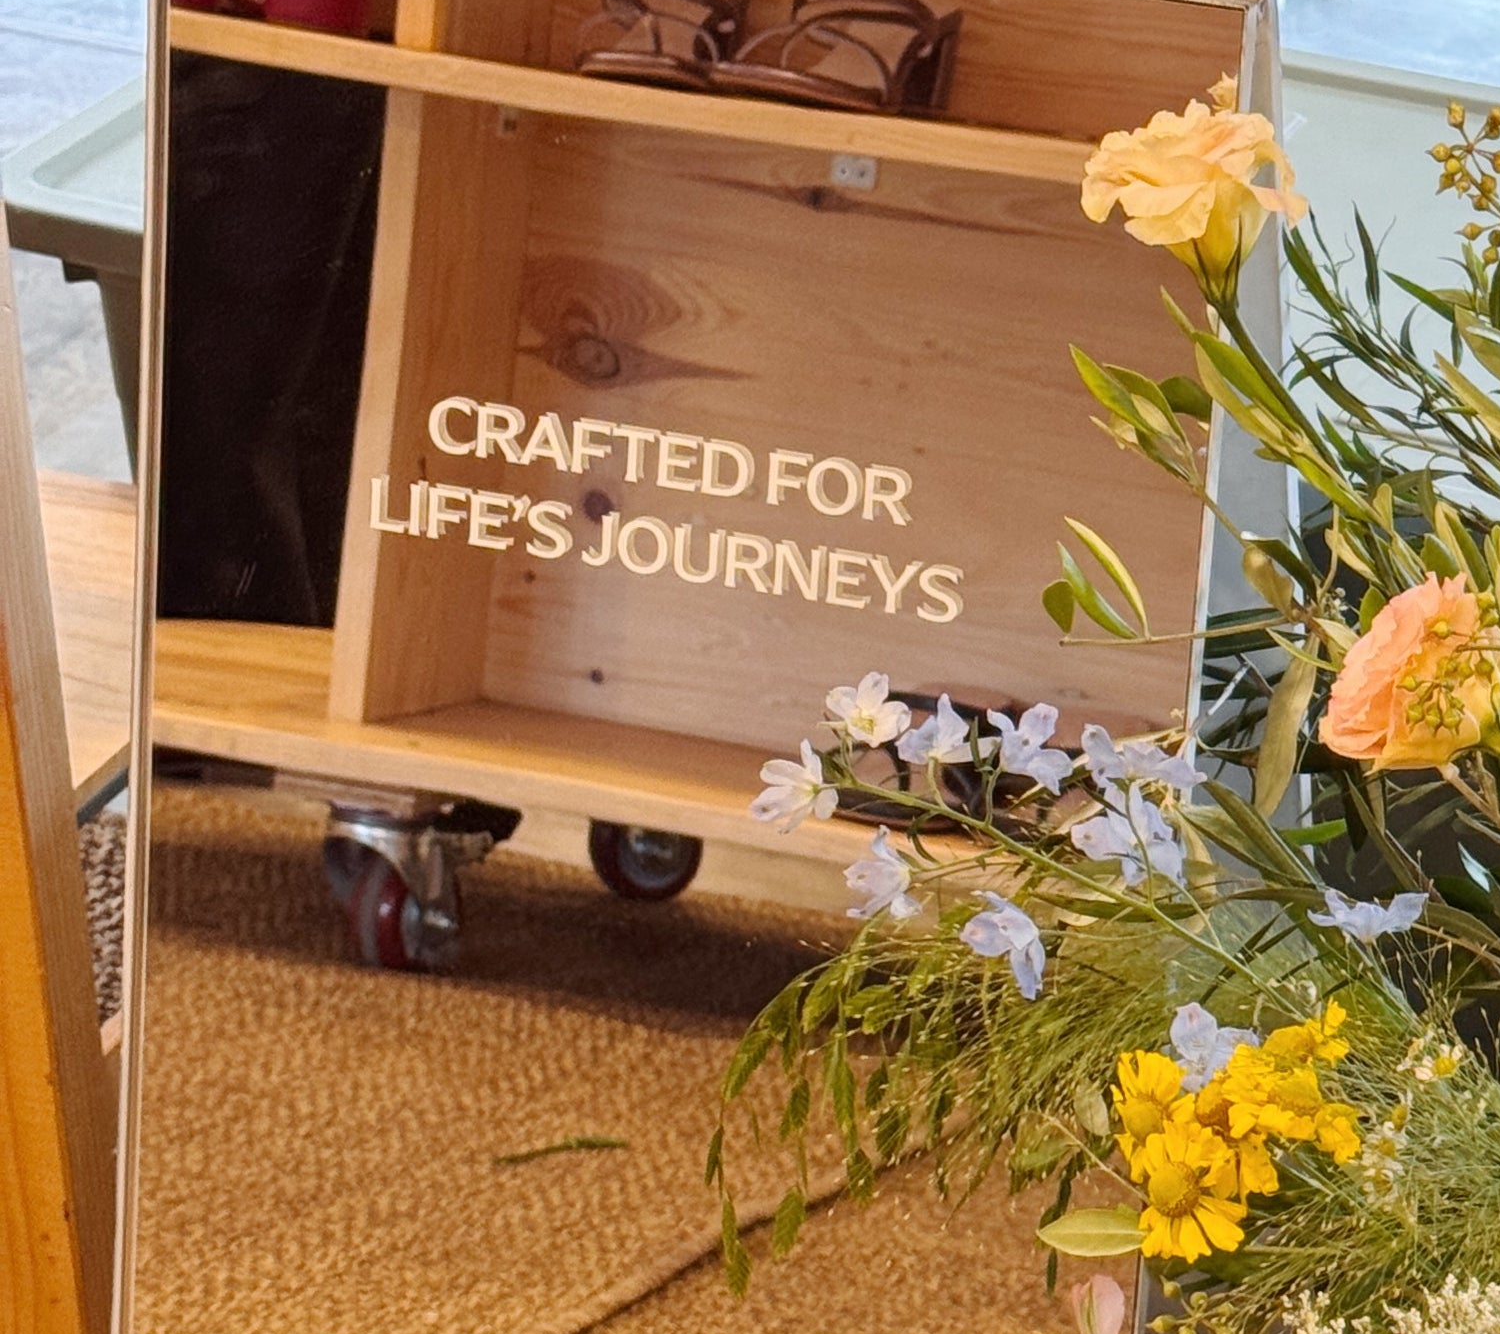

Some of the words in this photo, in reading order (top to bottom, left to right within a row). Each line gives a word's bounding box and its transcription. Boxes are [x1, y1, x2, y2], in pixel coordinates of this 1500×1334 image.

[428, 395, 756, 498] CRAFTED
[765, 448, 914, 527] FOR
[580, 510, 965, 624] JOURNEYS
